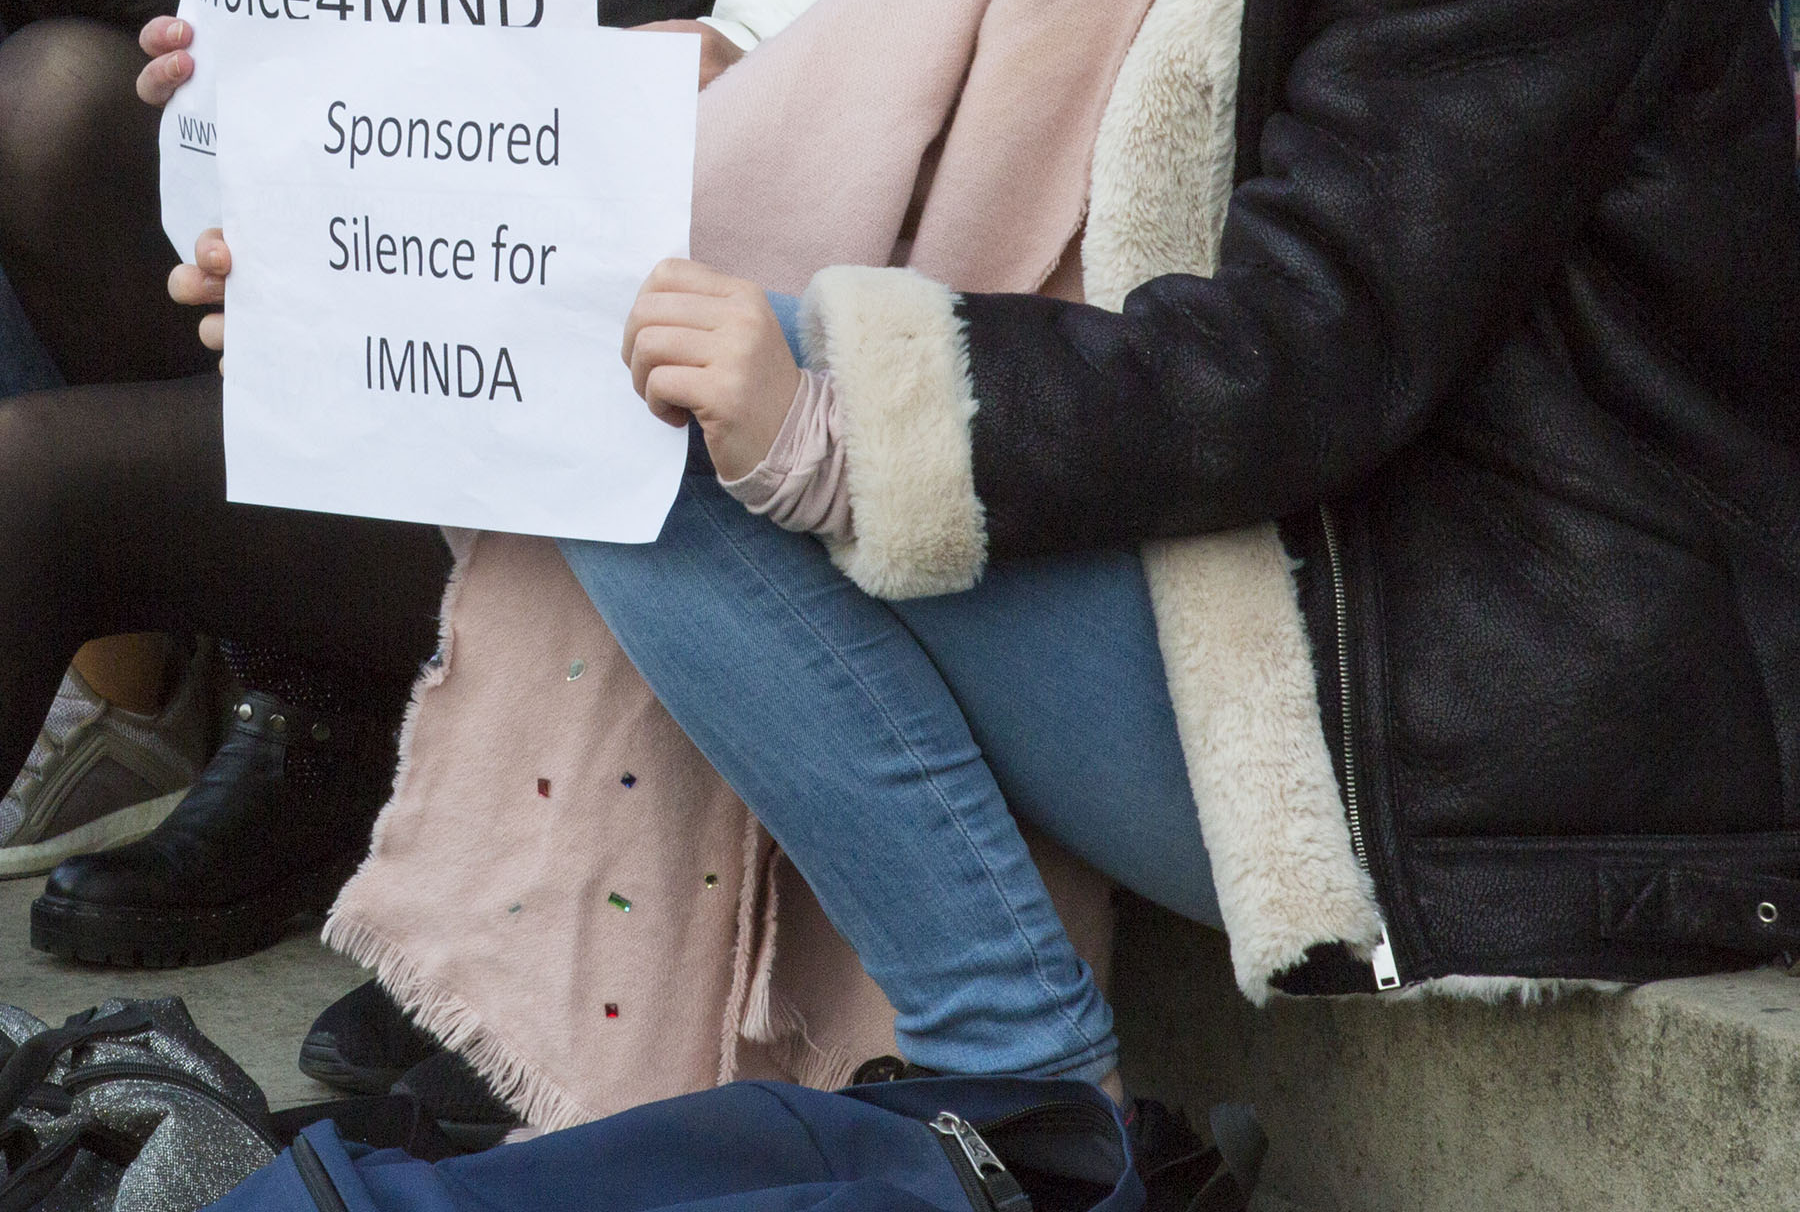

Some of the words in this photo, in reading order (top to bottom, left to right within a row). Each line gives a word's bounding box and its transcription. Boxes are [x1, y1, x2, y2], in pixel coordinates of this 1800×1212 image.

[322, 100, 561, 170] Sponsored
[329, 215, 476, 281] Silence
[491, 224, 558, 286] for
[366, 335, 524, 403] IMNDA
